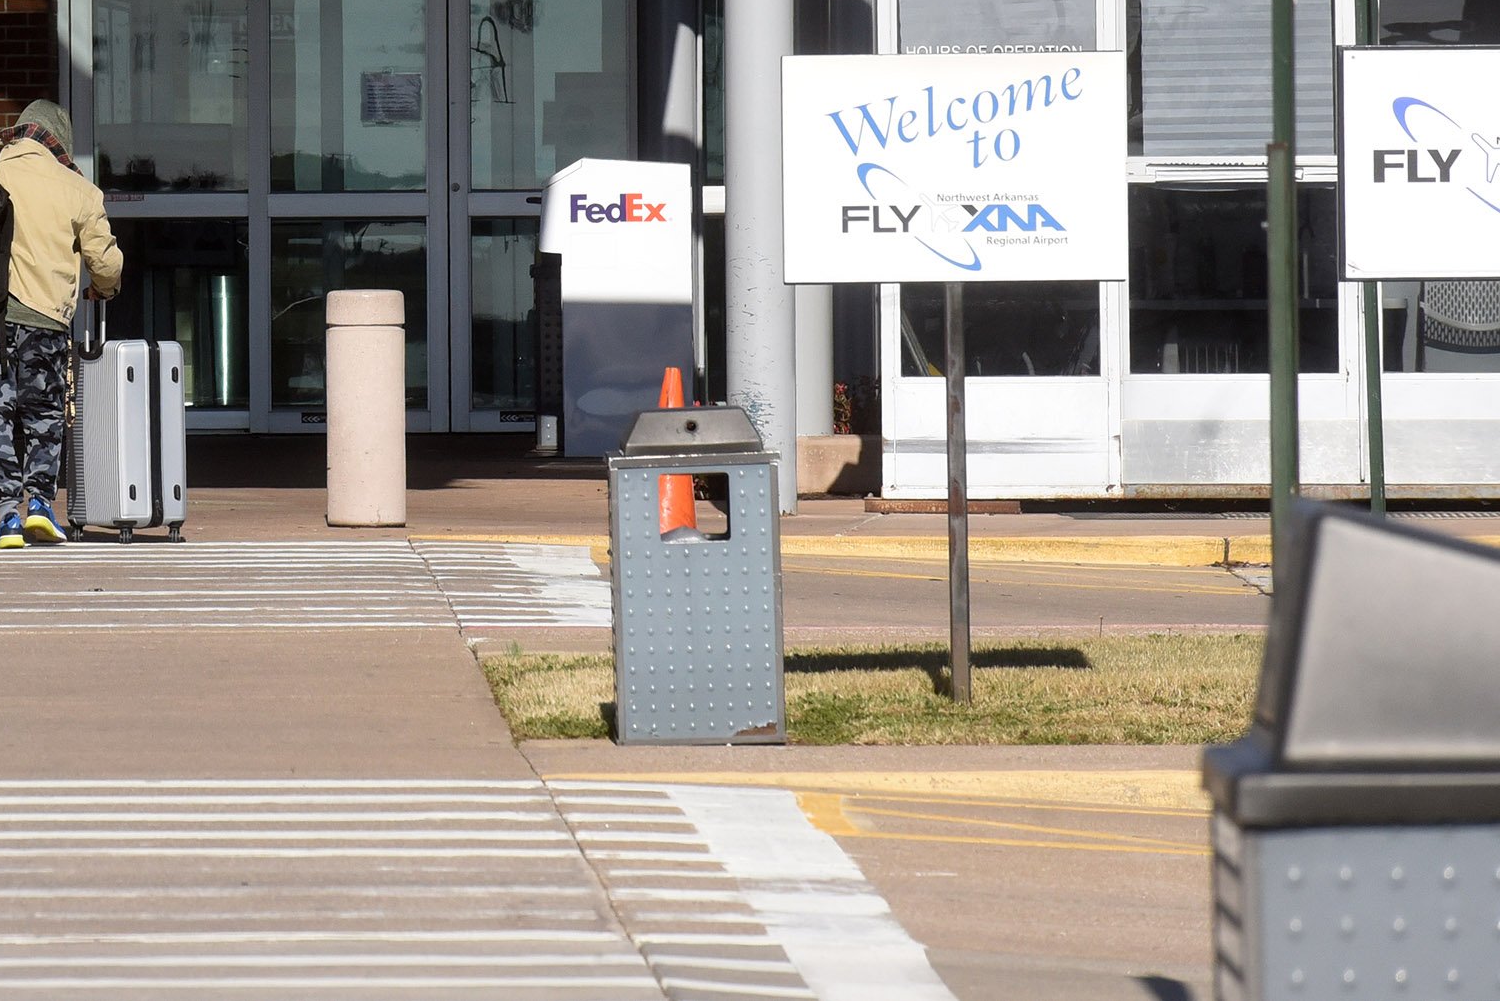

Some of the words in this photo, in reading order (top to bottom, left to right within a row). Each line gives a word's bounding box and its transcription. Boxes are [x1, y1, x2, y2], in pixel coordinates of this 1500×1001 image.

[824, 67, 1083, 157] Welcome
[966, 128, 1021, 169] to
[1373, 149, 1462, 183] FLY
[570, 193, 667, 223] FedEx
[937, 193, 990, 202] Northwest
[993, 192, 1039, 202] Arkansas
[842, 205, 922, 233] FLY
[961, 204, 1067, 233] XNA
[986, 235, 1031, 247] Regional
[1033, 235, 1069, 247] Airport
